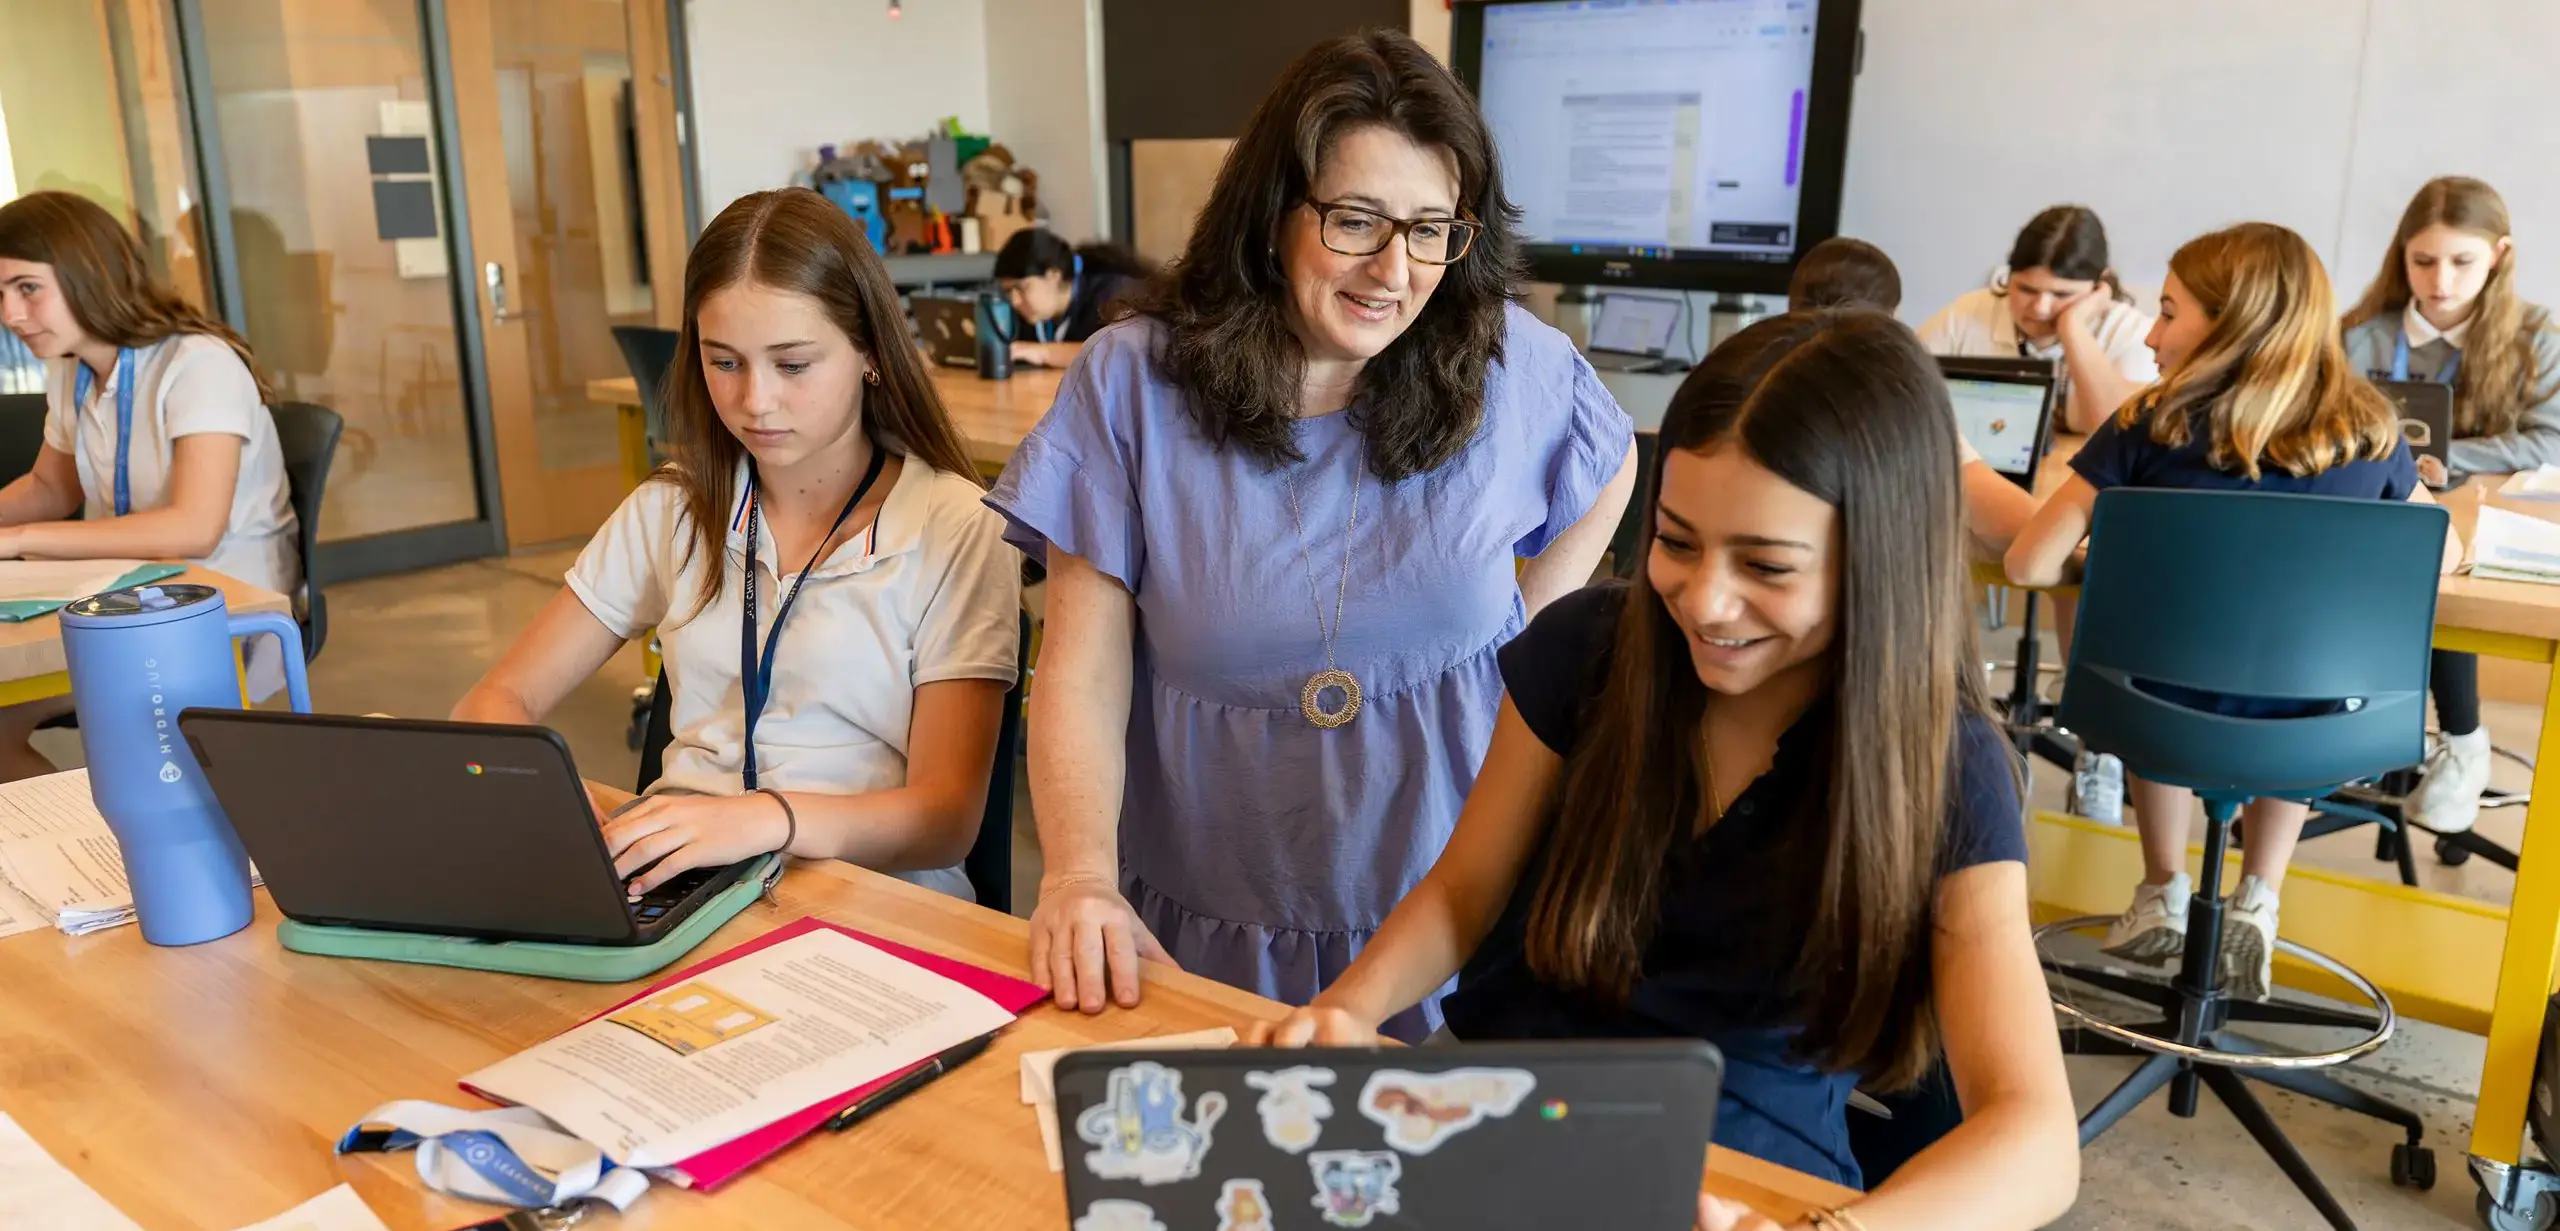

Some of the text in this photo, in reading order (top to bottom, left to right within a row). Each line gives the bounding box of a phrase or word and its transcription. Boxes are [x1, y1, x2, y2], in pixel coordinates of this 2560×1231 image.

[750, 510, 758, 535] HOLY
[746, 570, 754, 600] CHILD
[145, 658, 172, 754] HYDROJUG
